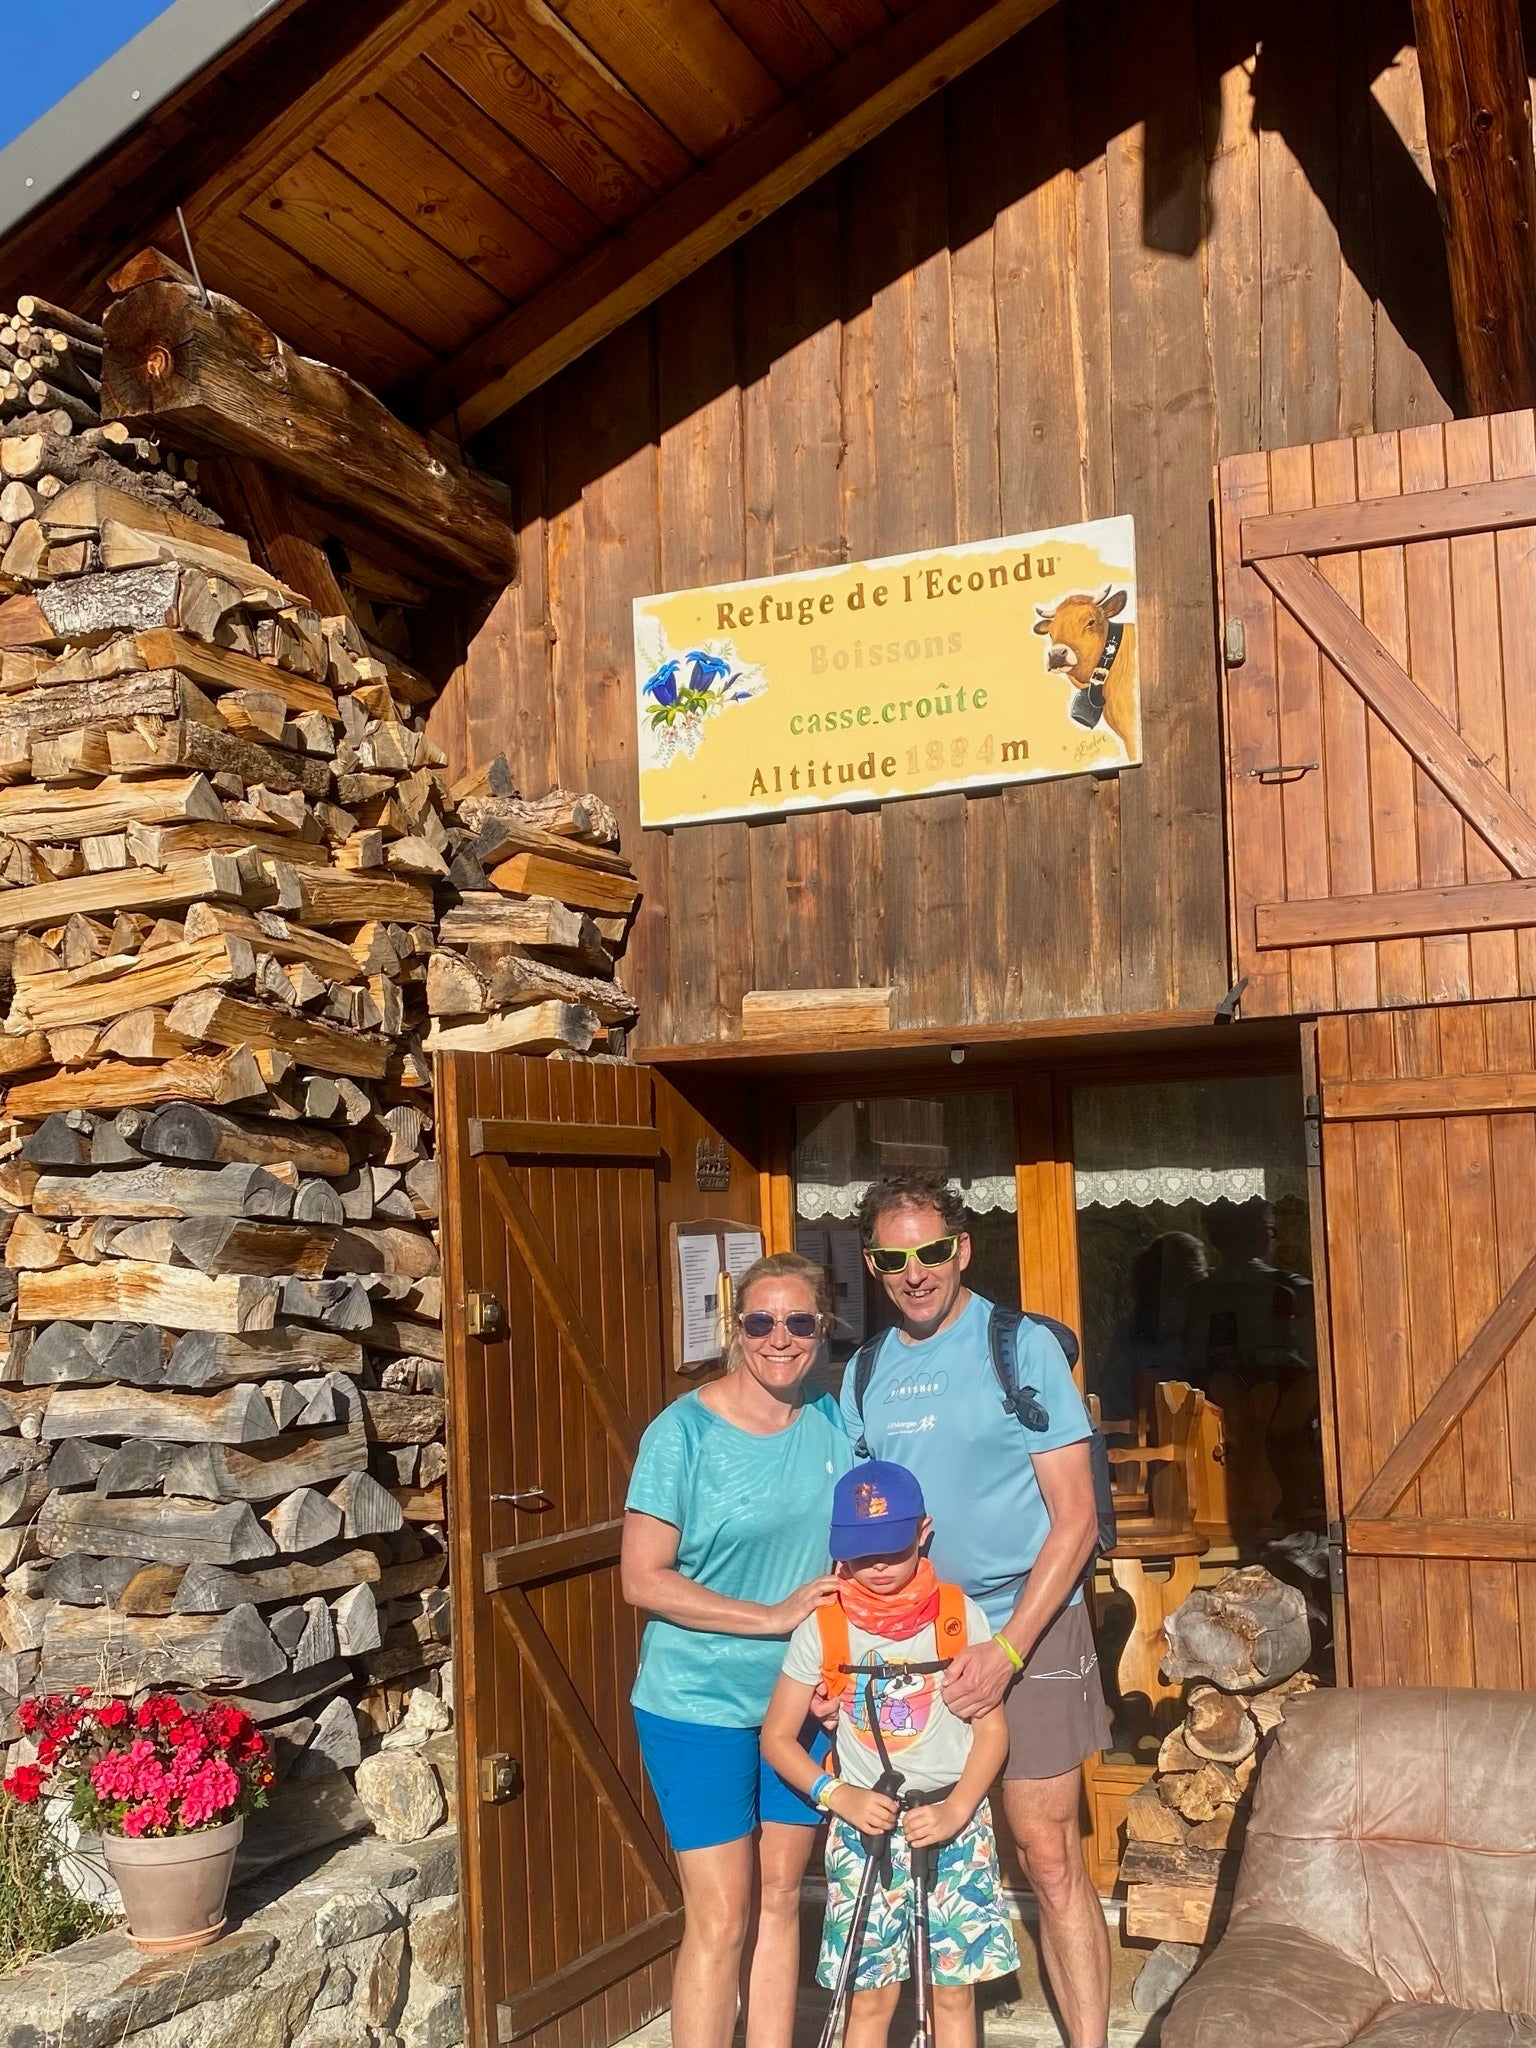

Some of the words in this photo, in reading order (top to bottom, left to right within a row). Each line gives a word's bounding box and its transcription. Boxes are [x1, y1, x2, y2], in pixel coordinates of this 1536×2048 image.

[717, 594, 834, 630] Refuge
[847, 582, 889, 611] de
[902, 553, 1056, 603] l'Econdu
[810, 632, 963, 675] Boissons
[749, 752, 897, 797] Altitude
[883, 1370, 949, 1405] 2020
[891, 1383, 939, 1398] FINISHER
